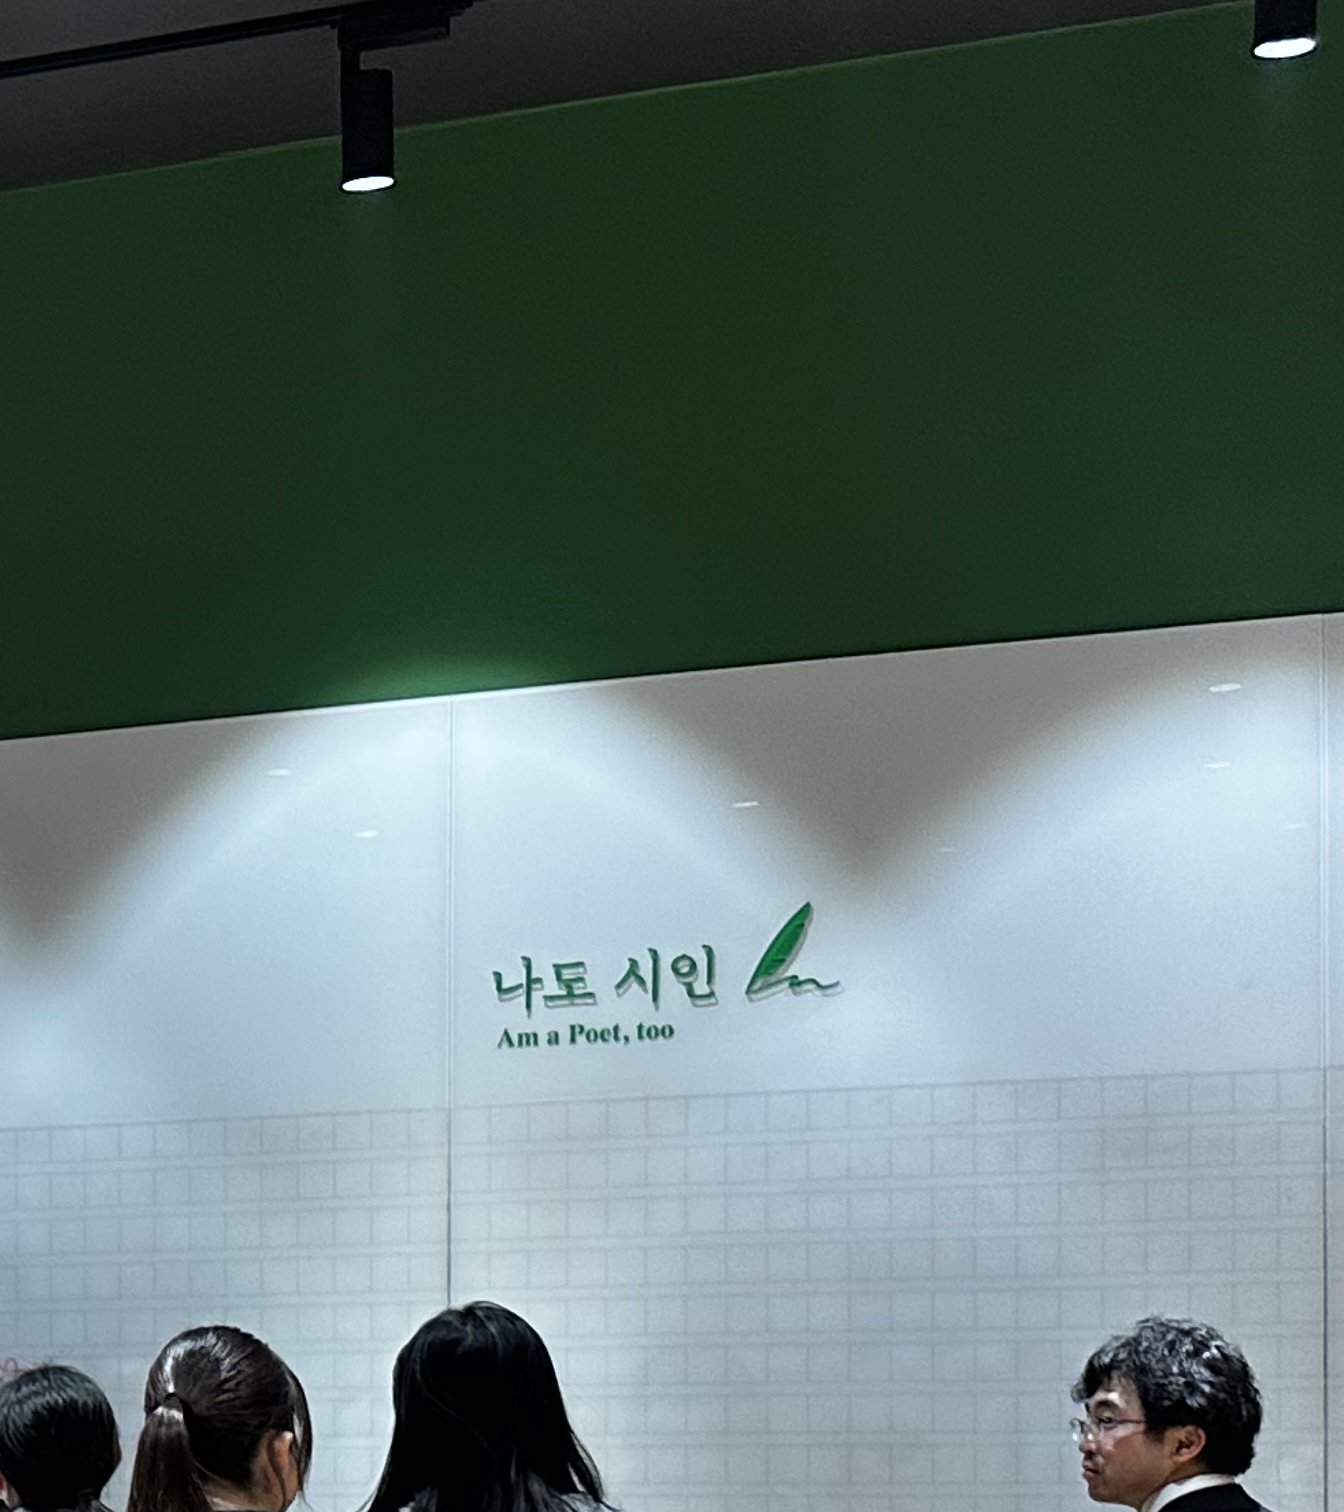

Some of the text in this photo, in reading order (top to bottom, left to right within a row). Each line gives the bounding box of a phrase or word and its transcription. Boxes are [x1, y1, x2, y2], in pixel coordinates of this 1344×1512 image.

[492, 944, 719, 1019] 나도 시인
[496, 1021, 676, 1050] Am a Poet, too
